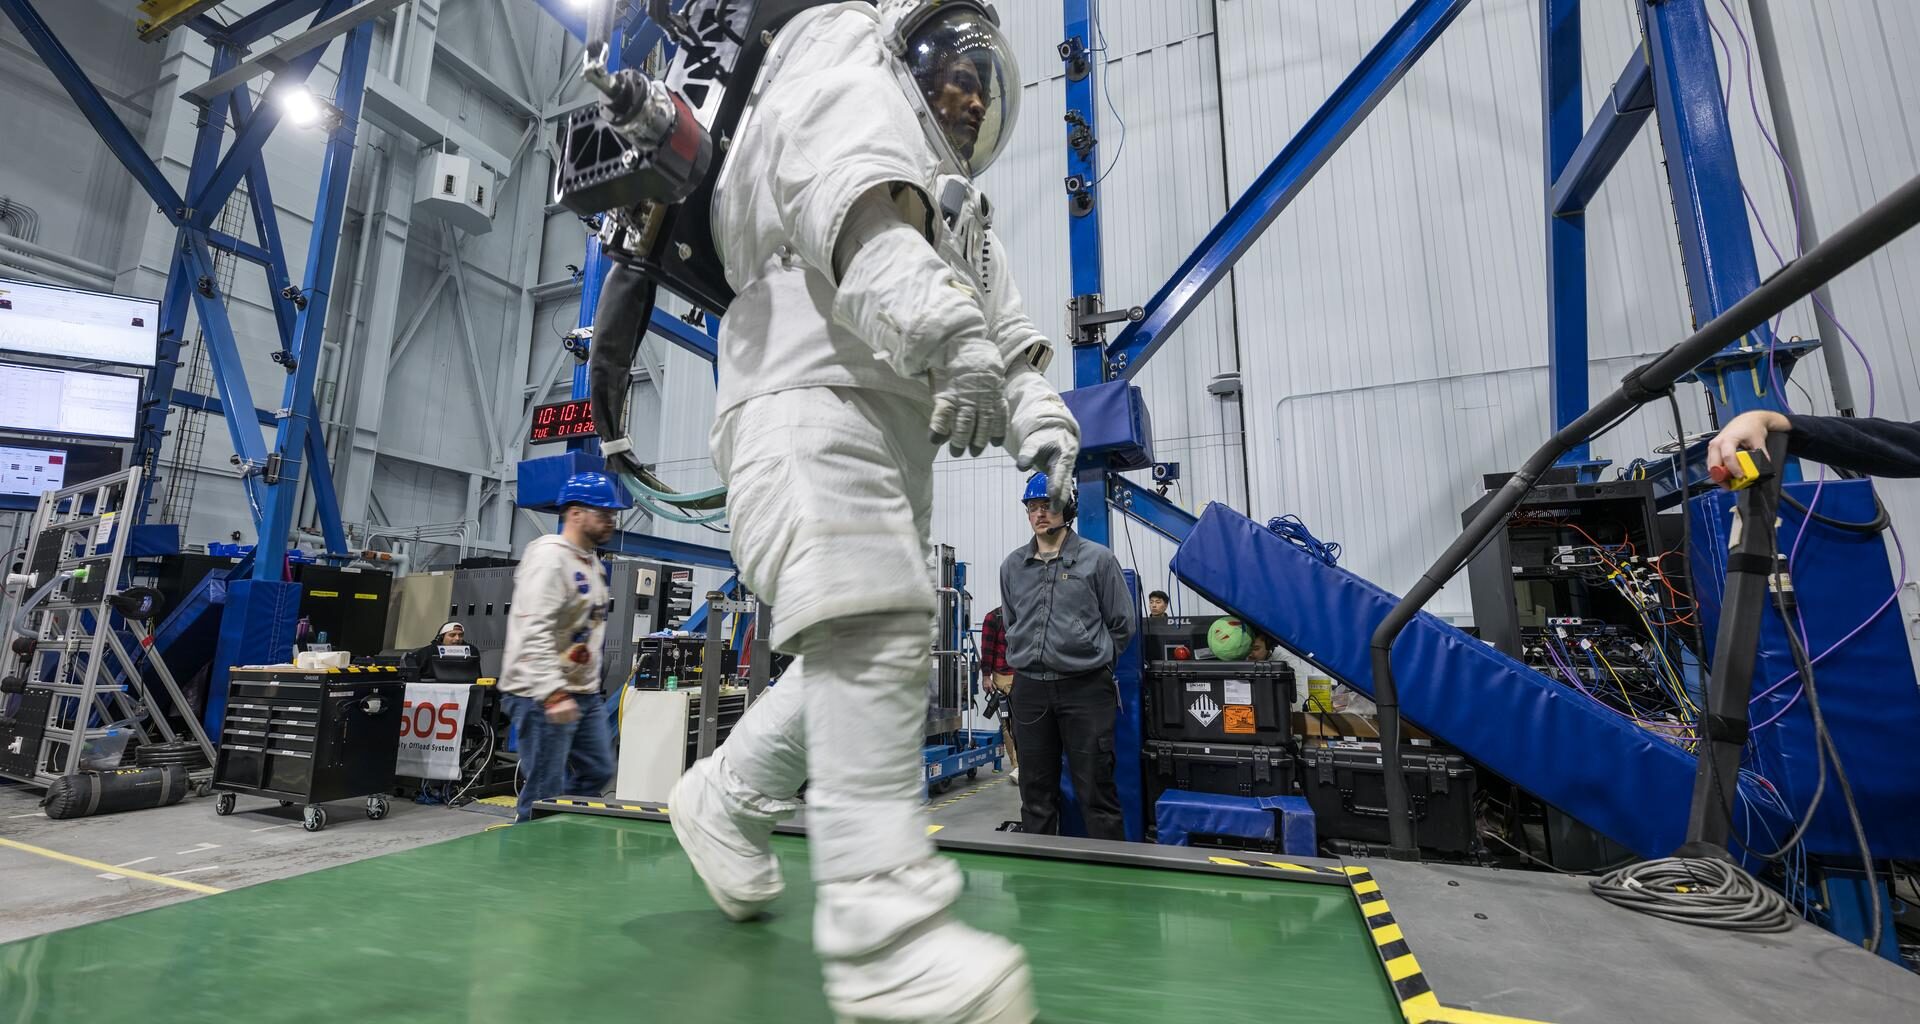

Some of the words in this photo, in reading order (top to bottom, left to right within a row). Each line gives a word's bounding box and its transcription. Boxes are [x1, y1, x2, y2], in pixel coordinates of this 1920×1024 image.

[534, 427, 549, 438] TUE
[408, 742, 431, 750] Offload
[431, 743, 455, 753] System
